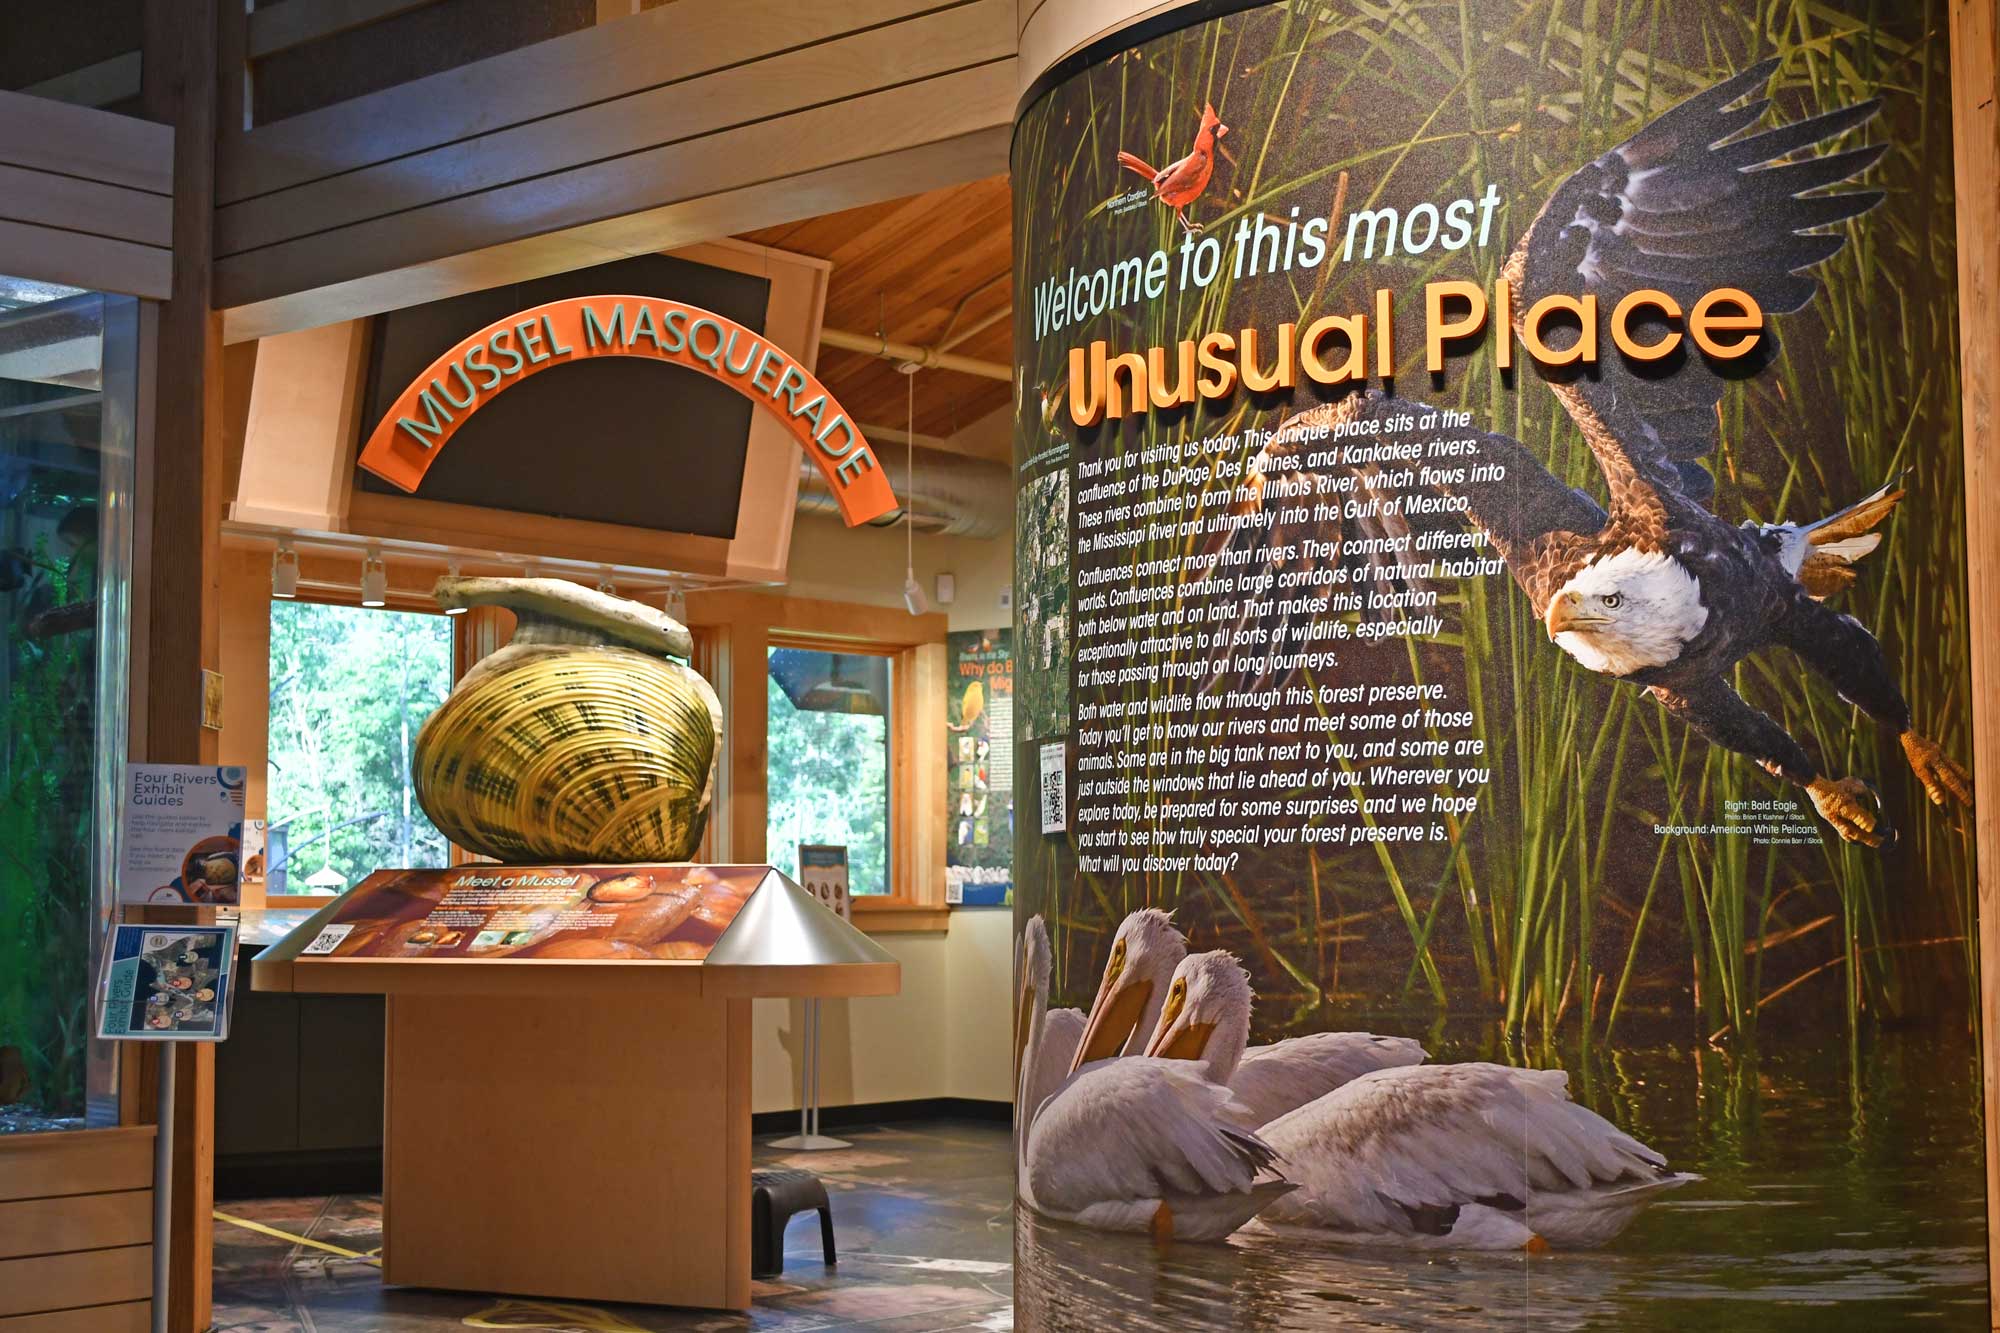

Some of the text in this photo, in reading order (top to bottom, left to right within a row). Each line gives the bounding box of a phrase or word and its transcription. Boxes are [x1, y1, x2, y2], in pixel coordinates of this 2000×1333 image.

[1033, 185, 1500, 342] Welcome to this most
[1069, 280, 1763, 427] Unusual Place
[398, 304, 873, 485] MUSSEL MASQUERADE
[1079, 458, 1102, 479] Thank
[1105, 458, 1121, 476] you
[1124, 451, 1138, 468] for
[1141, 444, 1180, 464] visiting
[1184, 443, 1198, 457] us
[1203, 434, 1240, 454] today.
[1244, 429, 1272, 448] This
[1277, 424, 1329, 444] unique
[1334, 417, 1380, 440] place
[1385, 413, 1414, 433] sits
[1419, 411, 1438, 430] at
[1441, 410, 1470, 428] the
[1078, 438, 1480, 504] confluence of the DuPage, Des Plaines, and Kankakee rivers.
[1078, 494, 1471, 553] the Mississippi River and ultimately into the Gulf of Mexico.
[1078, 588, 1436, 637] both below water and on land. That makes this location
[1078, 684, 1446, 720] Both water and wildlife flow through this forest preserve.
[1079, 728, 1102, 747] Today
[1133, 724, 1150, 745] get
[1153, 723, 1163, 739] to
[1167, 721, 1199, 738] know
[1202, 722, 1224, 736] our
[1228, 717, 1266, 735] rivers
[1271, 714, 1300, 733] and
[1304, 713, 1345, 731] meet
[1350, 714, 1396, 730] some
[1402, 709, 1420, 728] of
[1425, 709, 1473, 727] those
[1079, 753, 1114, 770] animals.
[1117, 751, 1146, 768] Some
[1149, 752, 1167, 766] are
[1171, 748, 1181, 764] in
[1186, 746, 1205, 764] the
[1209, 745, 1230, 767] big
[1235, 743, 1264, 761] tank
[1269, 742, 1301, 760] next
[1306, 742, 1320, 759] to
[1326, 744, 1357, 763] you,
[1363, 738, 1396, 757] and
[1400, 741, 1449, 756] some
[1455, 741, 1484, 755] are
[134, 783, 184, 795] Exhibit
[135, 772, 217, 785] Four Rivers
[1078, 766, 1489, 800] just outside the windows that lie ahead of you. Wherever you
[133, 794, 184, 807] Guides
[1079, 794, 1477, 824] explore today, be prepared for some surprises and we hope
[1724, 800, 1797, 812] Right: Bald Eagle
[1079, 822, 1447, 850] you start to see how truly special your forest preserve is.
[1654, 824, 1817, 836] Background: American White Pelicans
[455, 876, 499, 886] Meet
[516, 875, 581, 886] Mussel
[1080, 854, 1238, 875] What will you discover today?
